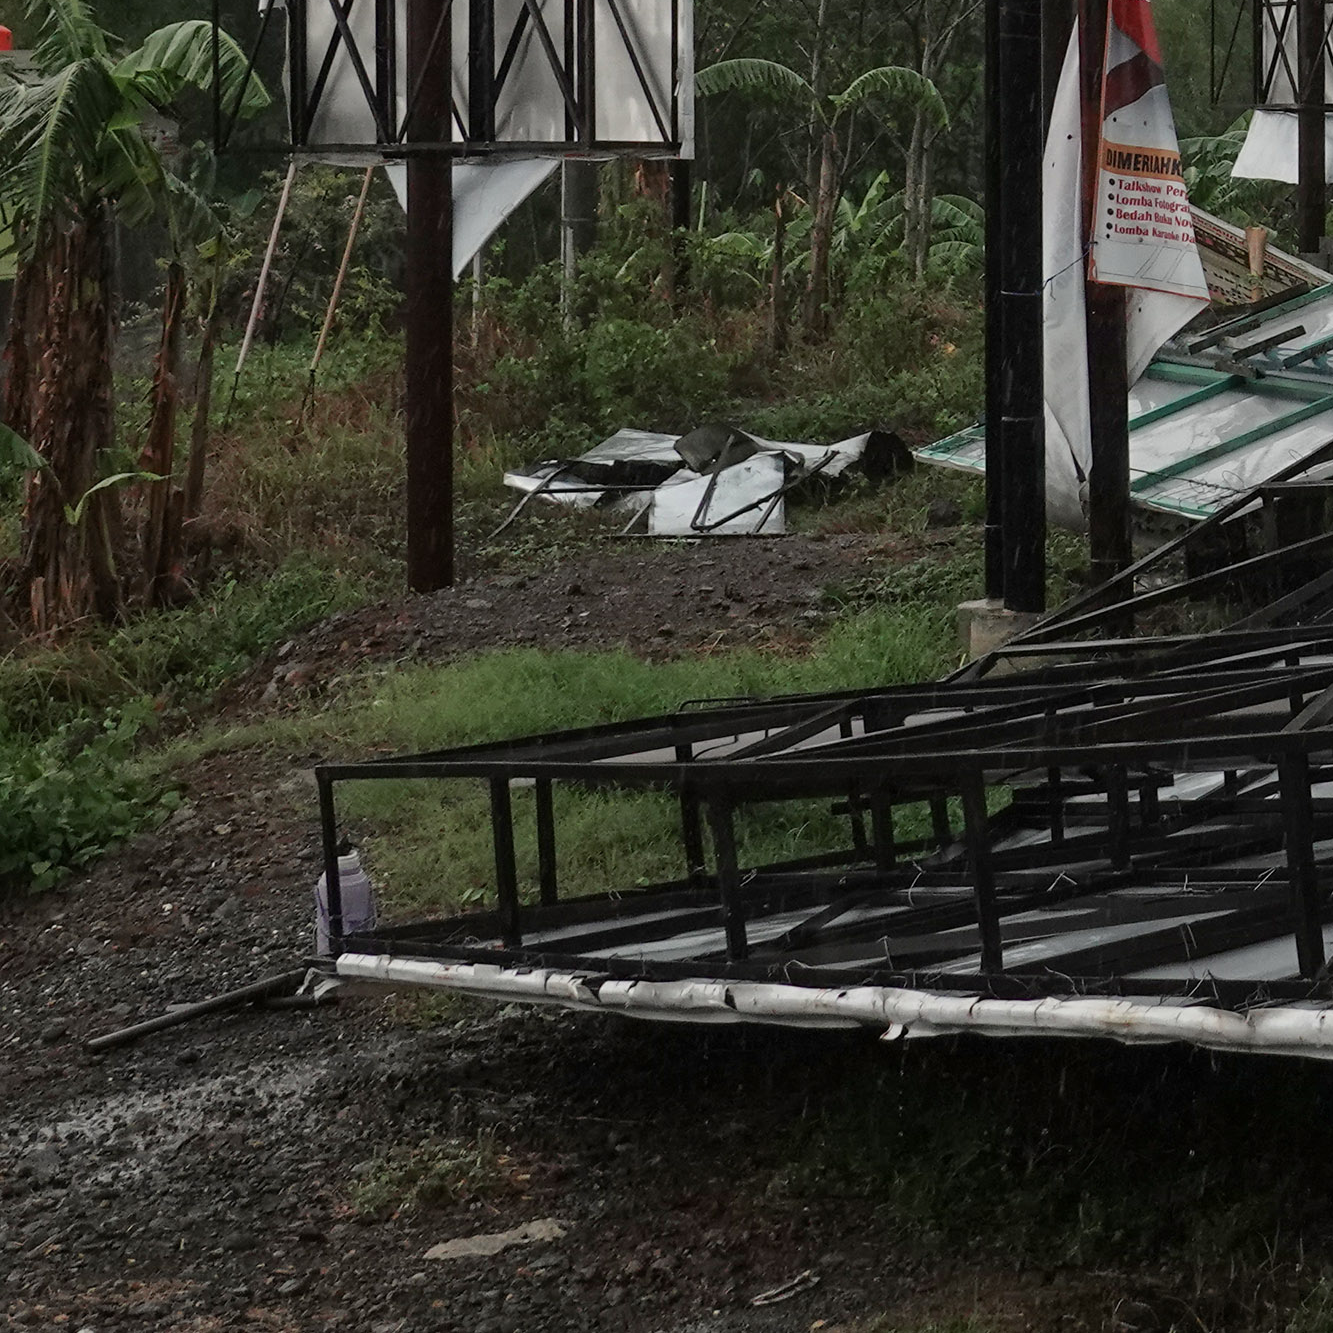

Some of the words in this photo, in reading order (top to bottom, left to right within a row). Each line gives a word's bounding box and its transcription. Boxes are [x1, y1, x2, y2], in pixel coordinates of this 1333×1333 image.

[1118, 179, 1162, 193] Talkshow
[1116, 194, 1153, 207] Lomba
[1115, 209, 1152, 221] Bedah
[1154, 212, 1173, 225] Buku
[1114, 224, 1149, 236] Lomba
